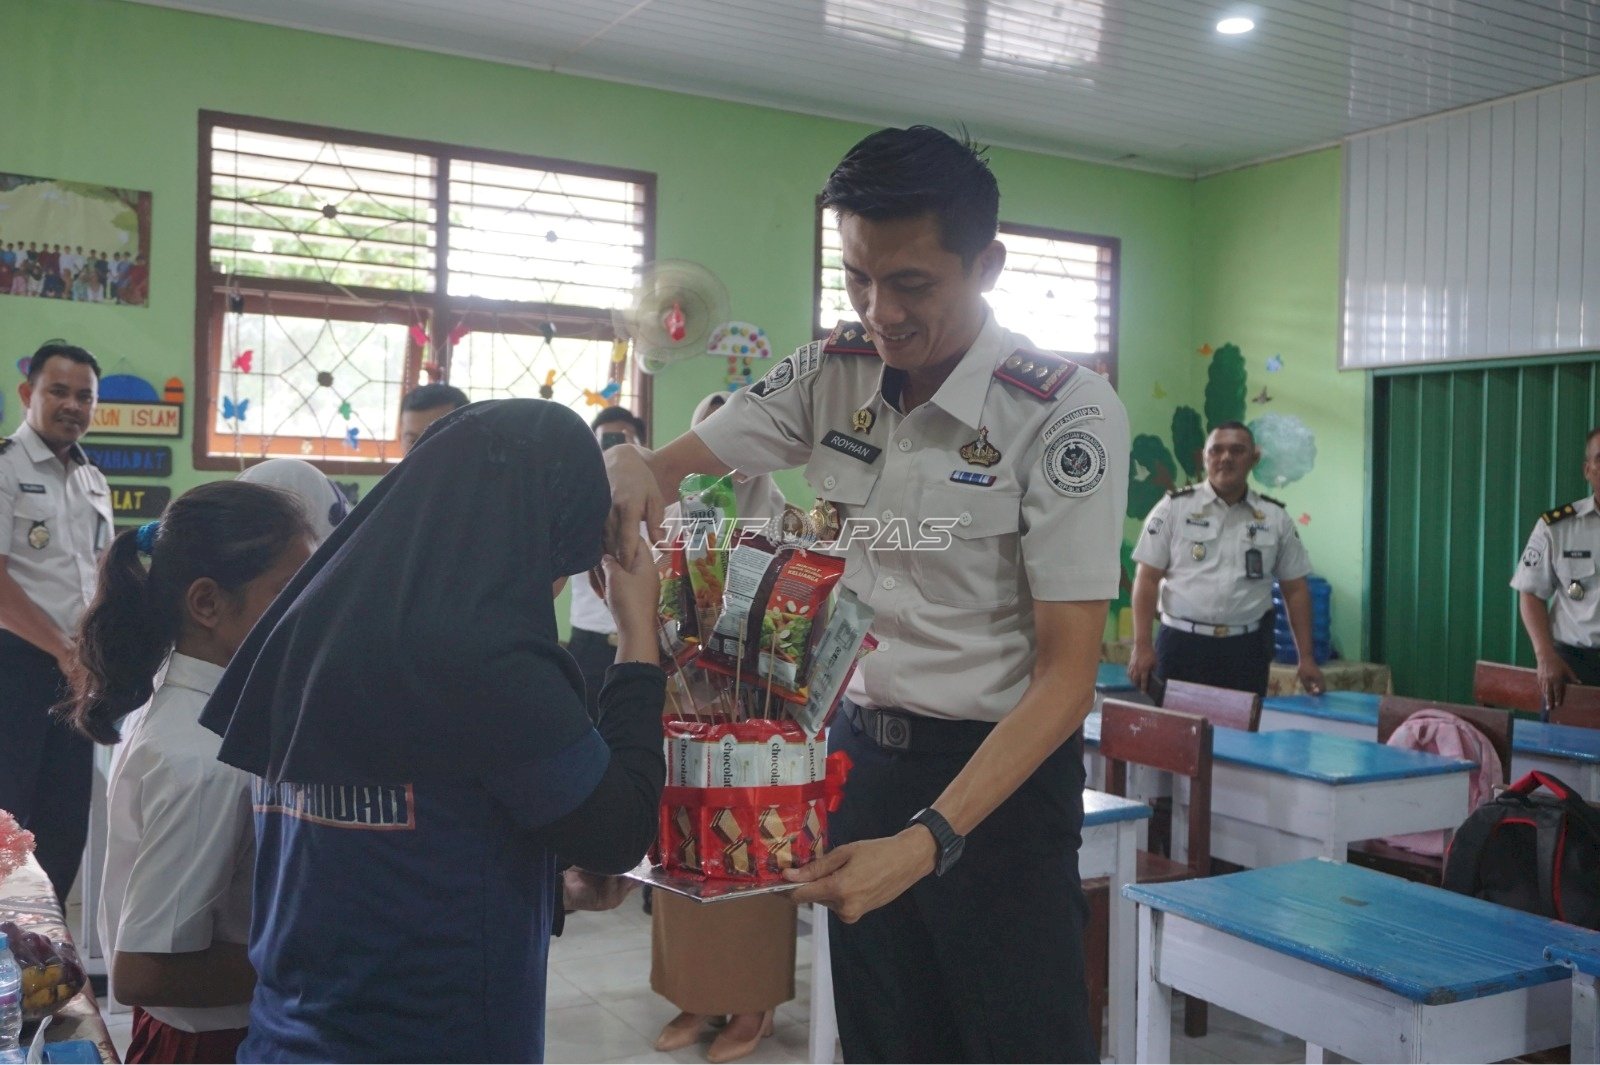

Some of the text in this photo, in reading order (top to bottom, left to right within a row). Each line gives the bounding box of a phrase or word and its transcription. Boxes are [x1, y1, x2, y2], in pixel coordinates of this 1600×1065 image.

[93, 409, 177, 427] KUN ISLAM
[1044, 407, 1100, 440] KEMENIMIPAS
[830, 435, 870, 457] ROYHAN
[85, 449, 166, 469] YAHADAT
[113, 490, 145, 510] LAT
